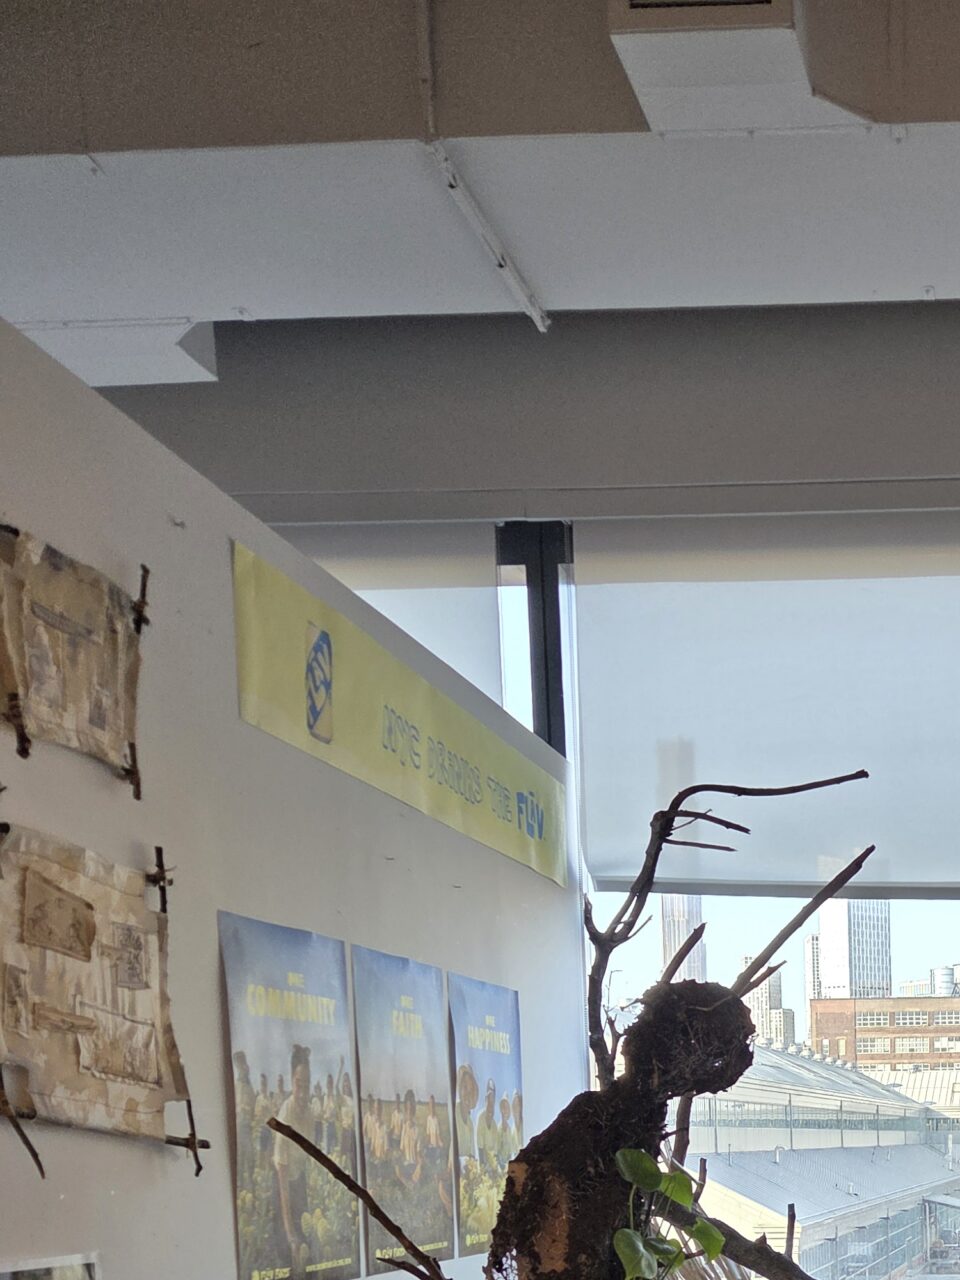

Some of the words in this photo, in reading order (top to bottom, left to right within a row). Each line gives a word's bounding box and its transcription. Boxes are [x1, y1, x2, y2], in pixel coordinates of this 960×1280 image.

[487, 775, 513, 823] THE
[246, 983, 337, 1026] COMMUNITY
[391, 1009, 424, 1039] FAITH
[467, 1024, 511, 1055] HAPPINESS
